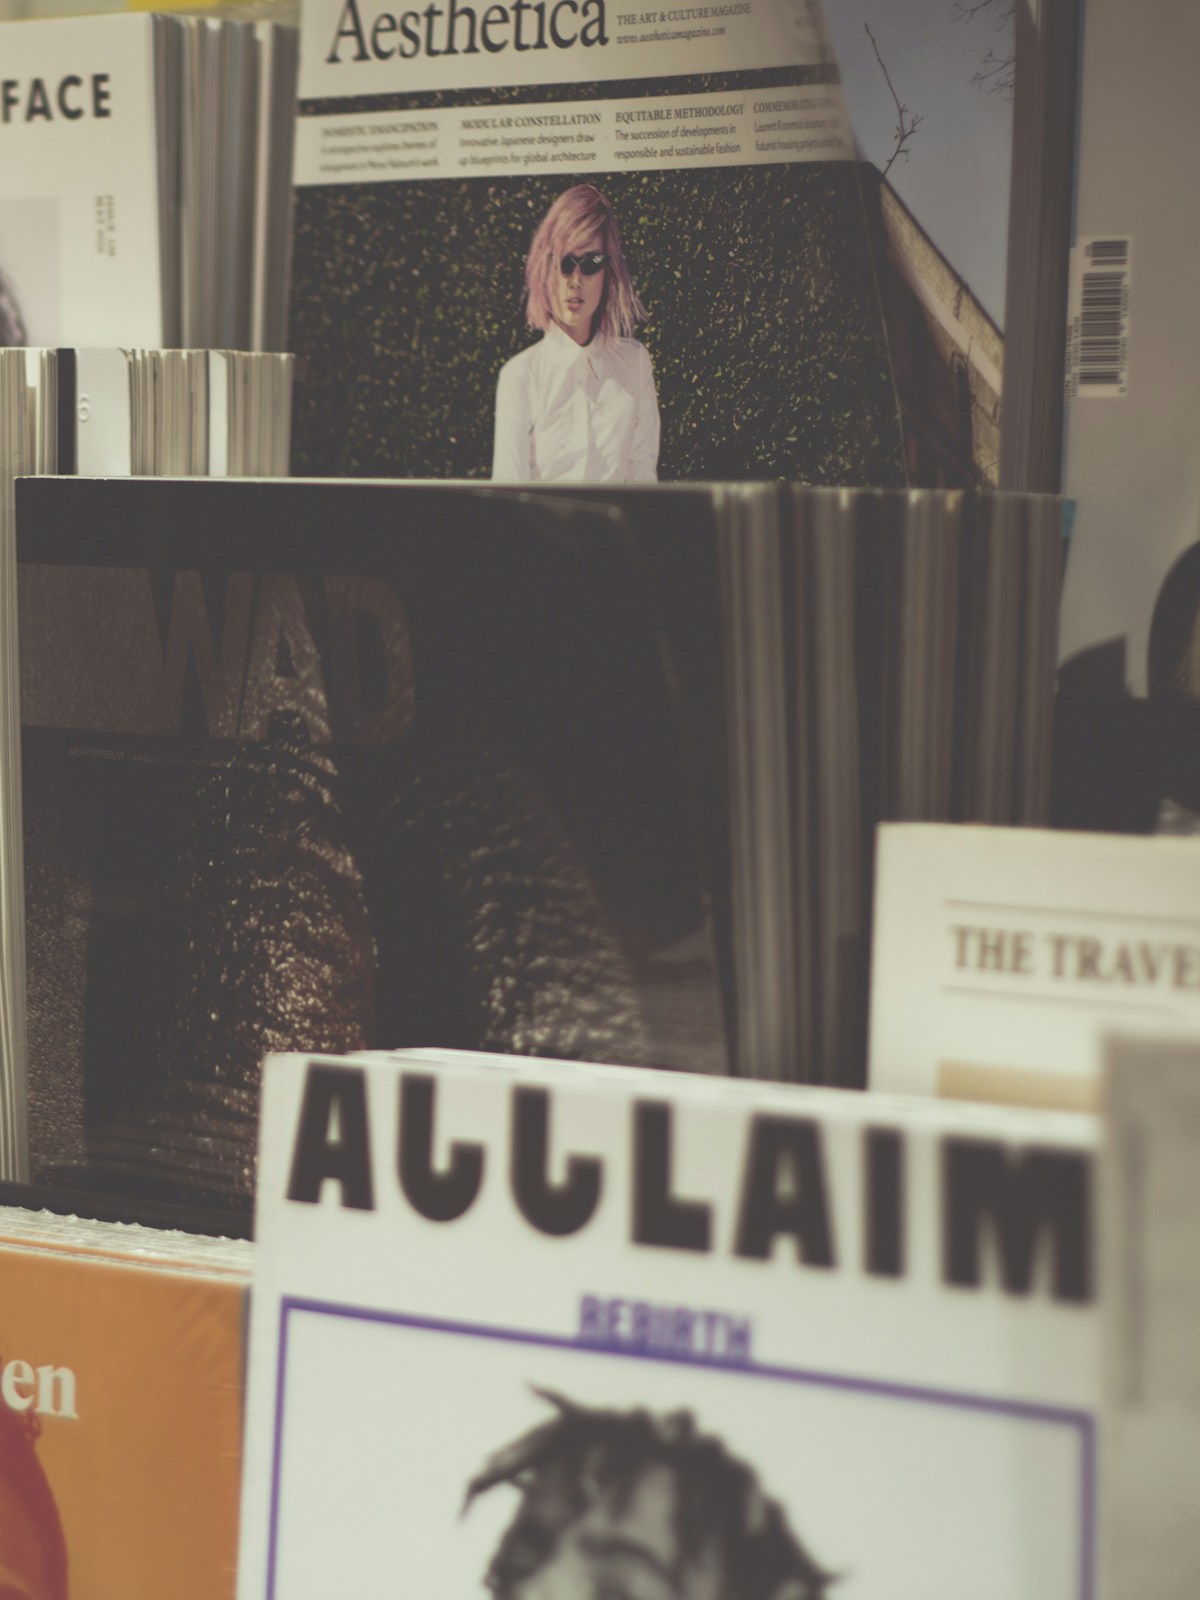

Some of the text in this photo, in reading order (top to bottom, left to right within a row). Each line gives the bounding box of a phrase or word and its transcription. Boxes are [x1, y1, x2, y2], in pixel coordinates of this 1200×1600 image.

[325, 0, 611, 64] Aesthetica
[617, 2, 752, 27] THE ART & CULTURE MAGAZINE
[460, 112, 602, 130] MODULAR CONSTELLATION
[615, 103, 745, 124] EQUITABLE METHODOLOGY
[615, 124, 737, 141] The succession of developments in
[614, 141, 742, 162] responsible and sustainable fashion
[123, 566, 416, 745] WAD
[950, 922, 1035, 977] THE
[285, 1061, 1098, 1306] ACCLAIM
[579, 1293, 751, 1360] REBIRTH
